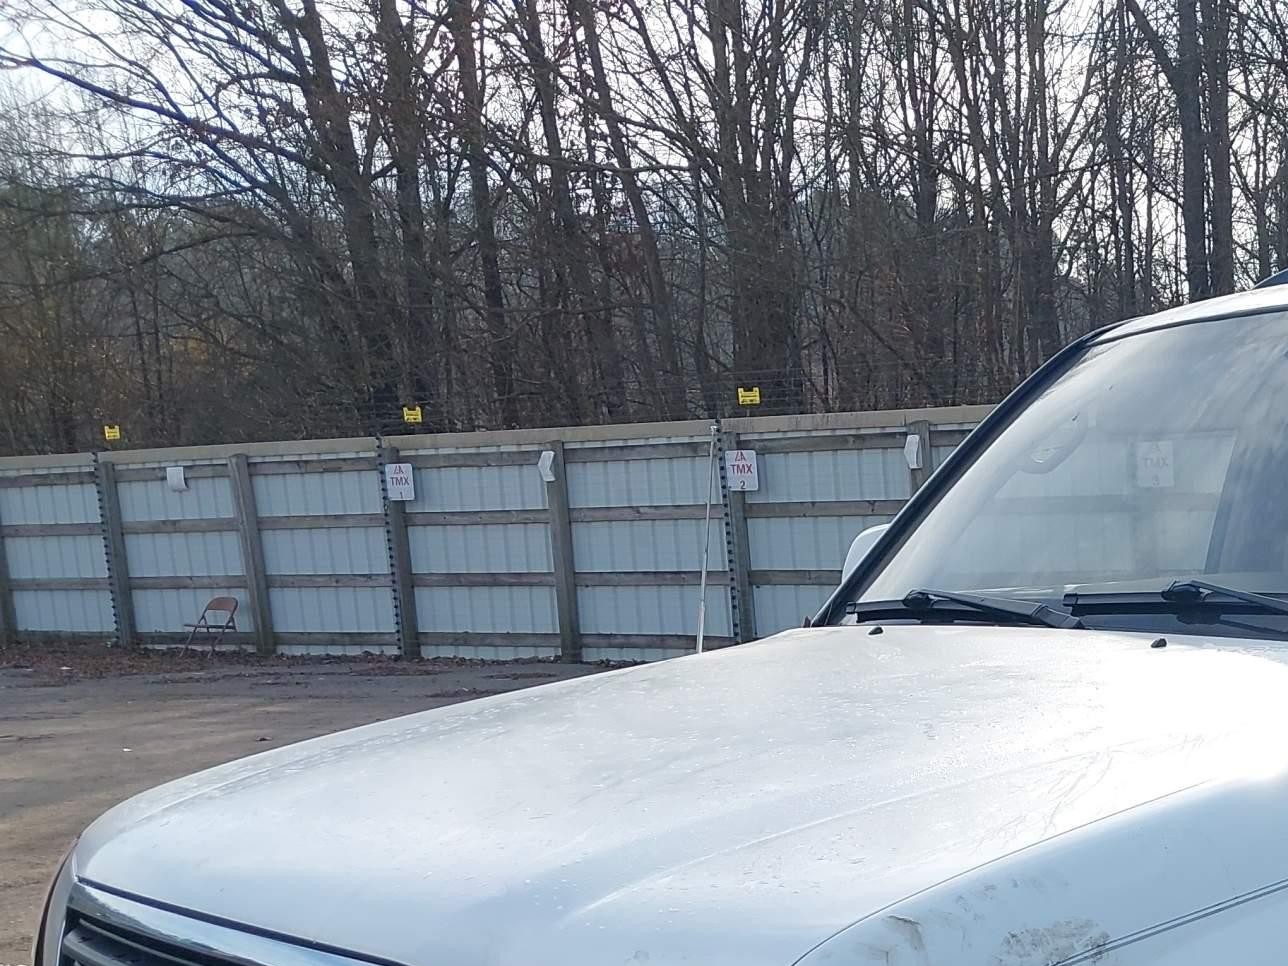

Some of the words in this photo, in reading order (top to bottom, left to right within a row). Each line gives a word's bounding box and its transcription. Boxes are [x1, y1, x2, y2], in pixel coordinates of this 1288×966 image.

[729, 464, 753, 475] TMX
[390, 477, 410, 486] TMX
[740, 480, 746, 490] 2
